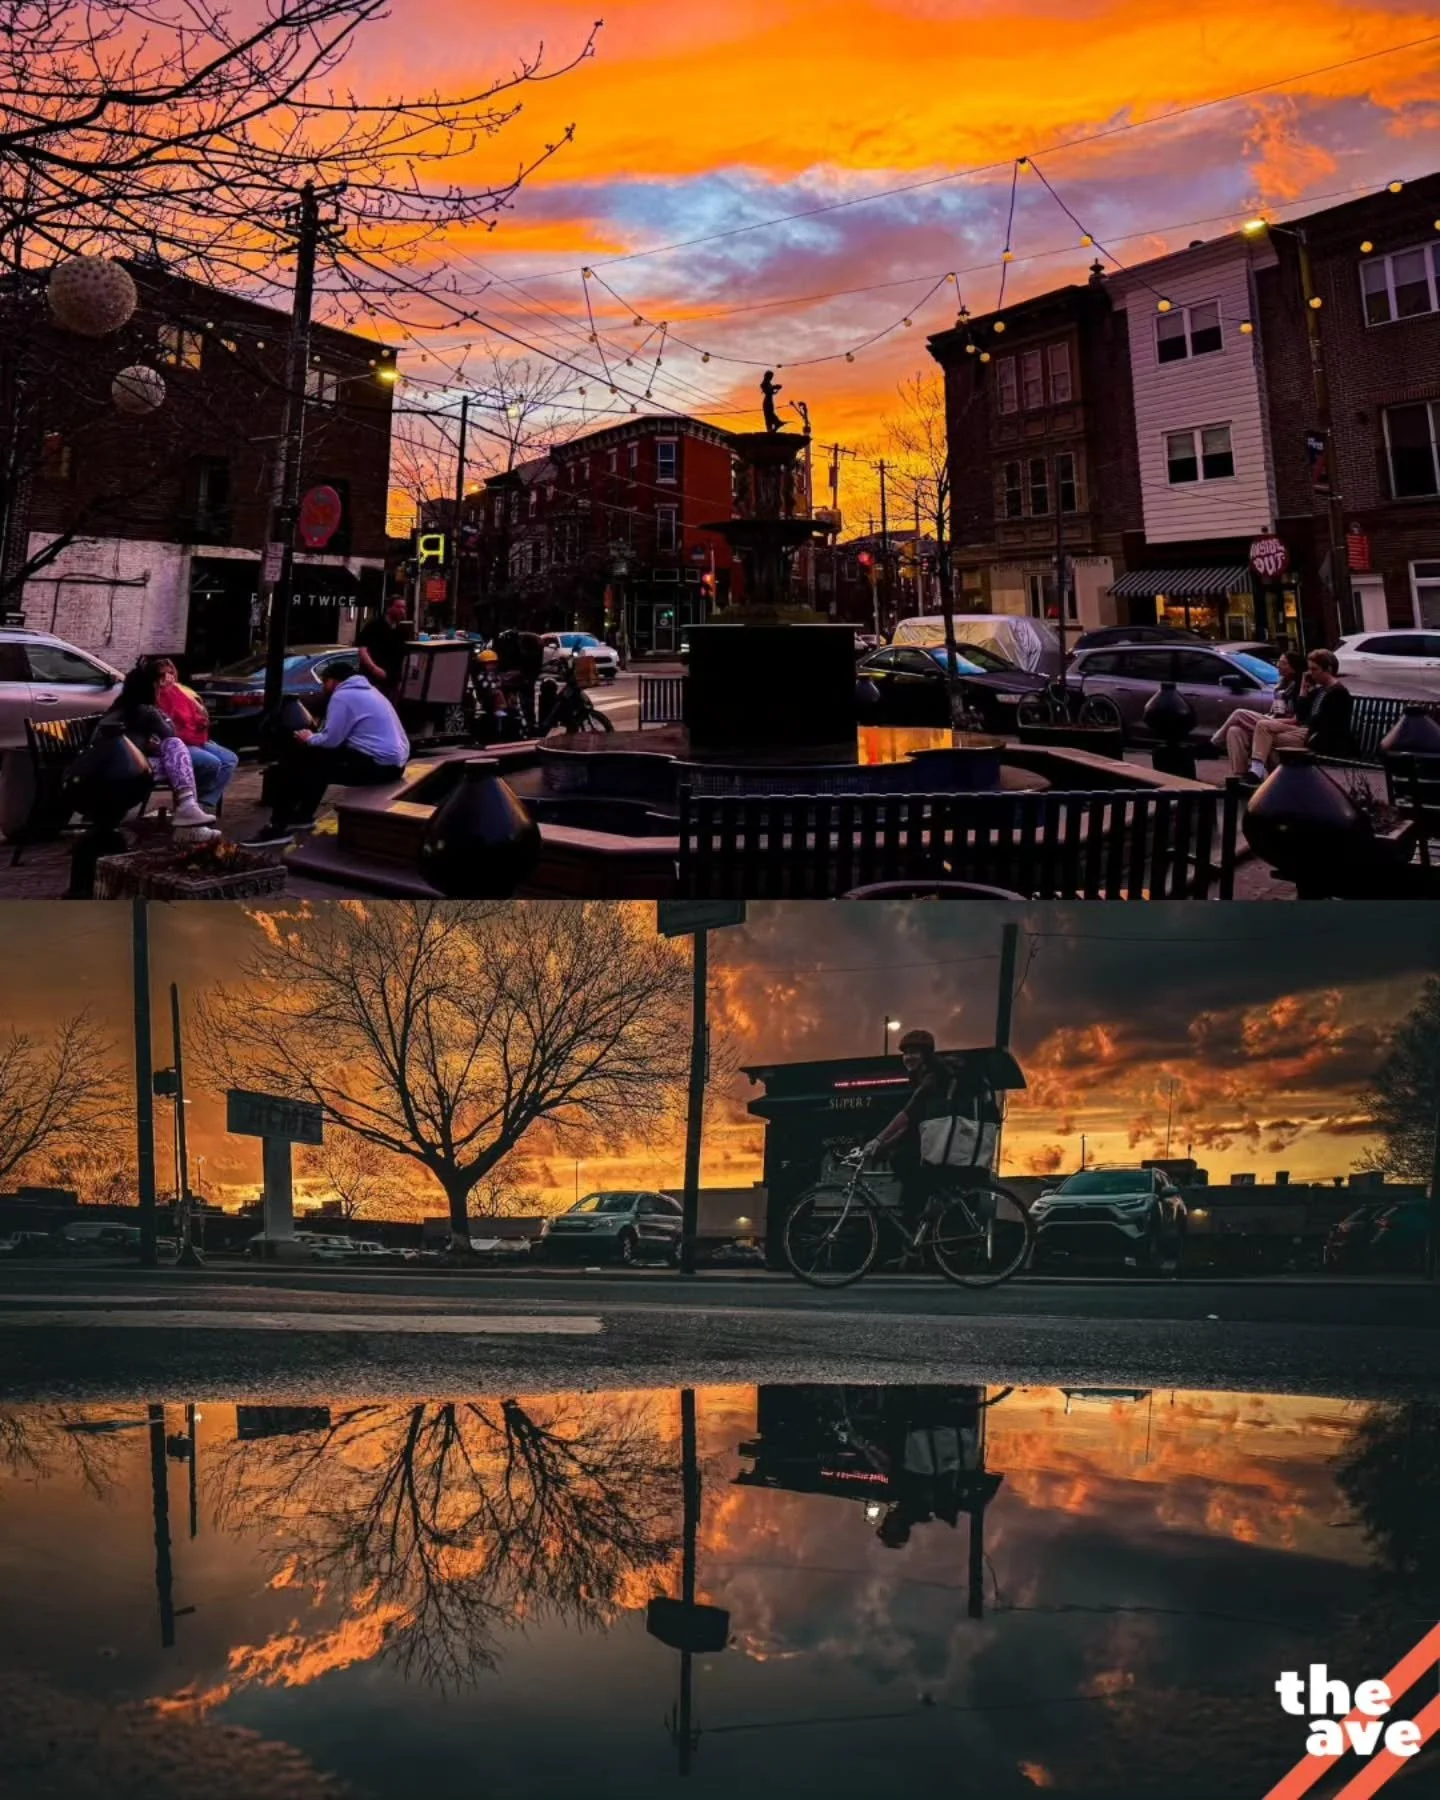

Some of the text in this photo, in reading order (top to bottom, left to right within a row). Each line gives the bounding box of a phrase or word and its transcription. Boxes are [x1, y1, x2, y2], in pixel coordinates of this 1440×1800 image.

[1253, 552, 1285, 576] OUT
[307, 595, 356, 607] TWICE
[829, 1096, 863, 1109] SUPER
